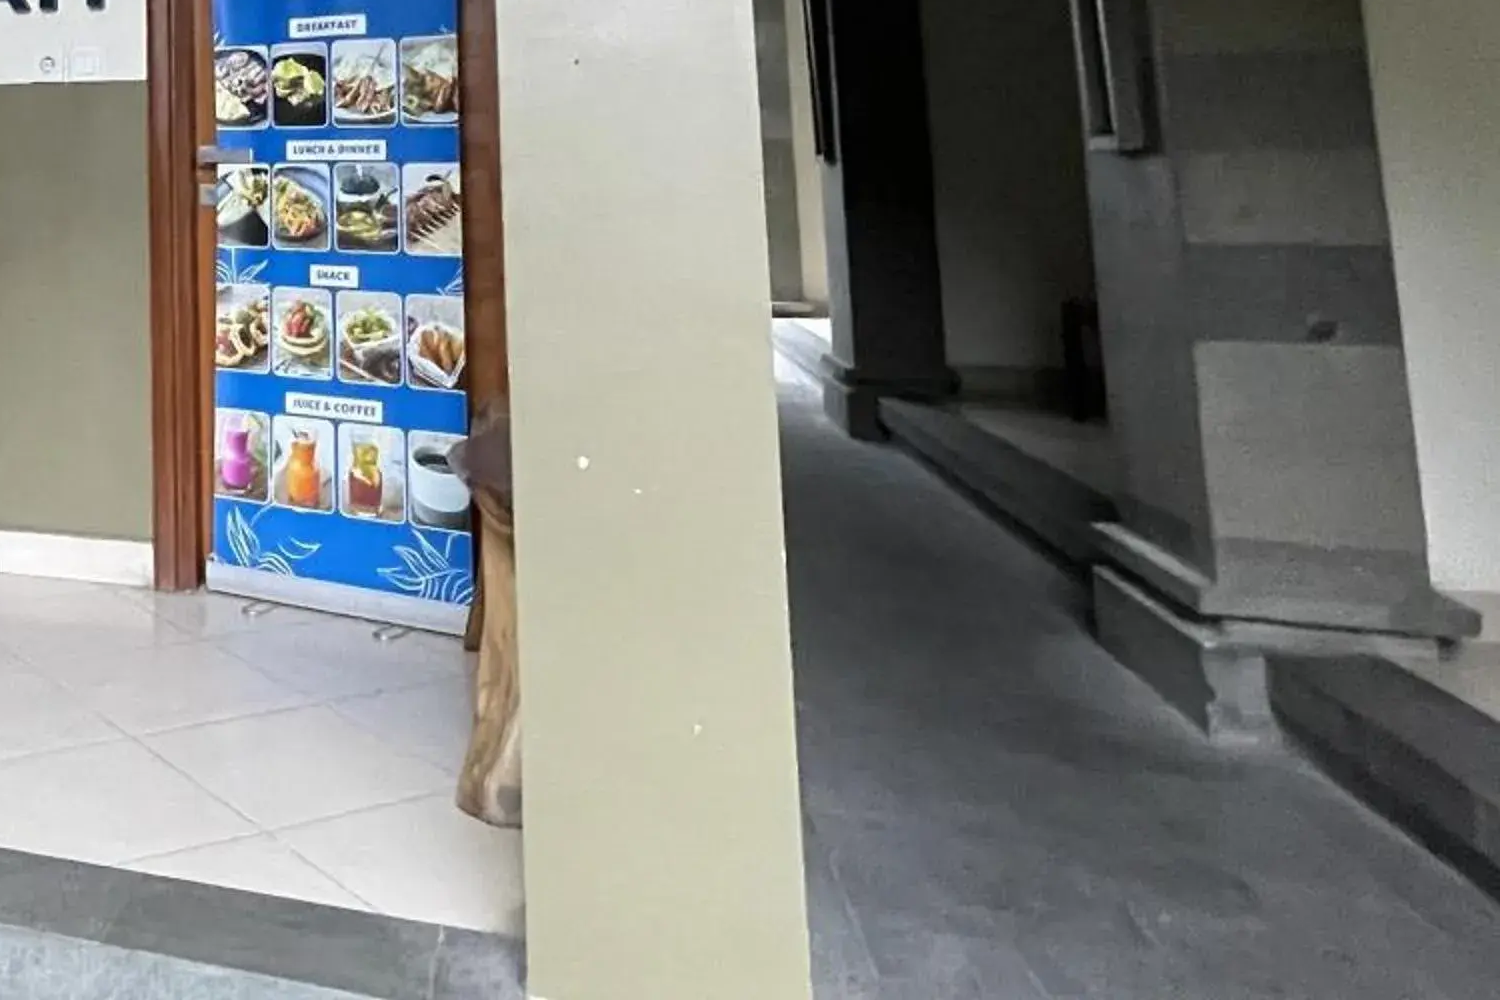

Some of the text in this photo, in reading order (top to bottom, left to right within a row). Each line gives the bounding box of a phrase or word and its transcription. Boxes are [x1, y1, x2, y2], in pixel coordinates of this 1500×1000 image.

[293, 144, 325, 155] LUNCH
[337, 144, 381, 155] DINNER
[316, 269, 351, 281] SNACK
[292, 399, 322, 411] JUICE
[333, 403, 377, 418] COFFEE
